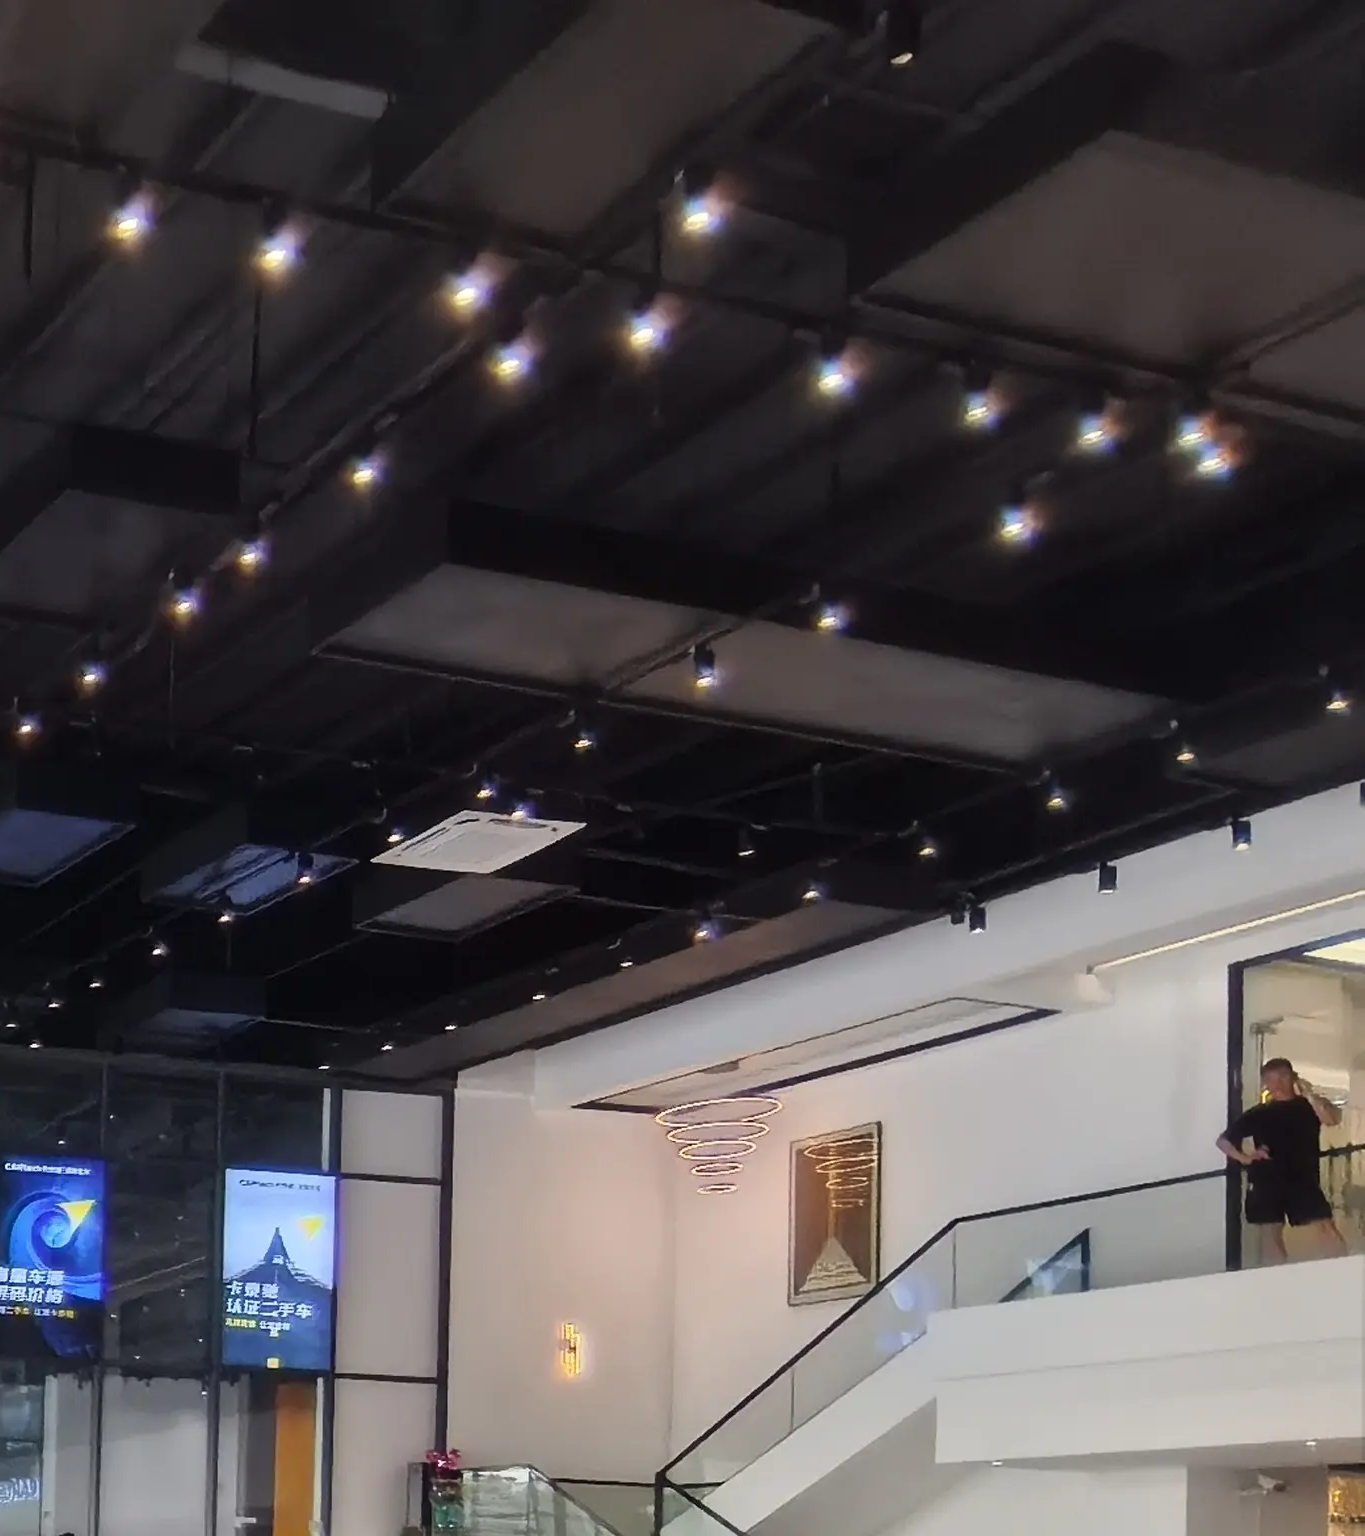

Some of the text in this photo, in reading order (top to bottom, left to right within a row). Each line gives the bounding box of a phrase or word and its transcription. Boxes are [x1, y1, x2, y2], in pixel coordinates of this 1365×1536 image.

[225, 1298, 313, 1320] 认证二手车
